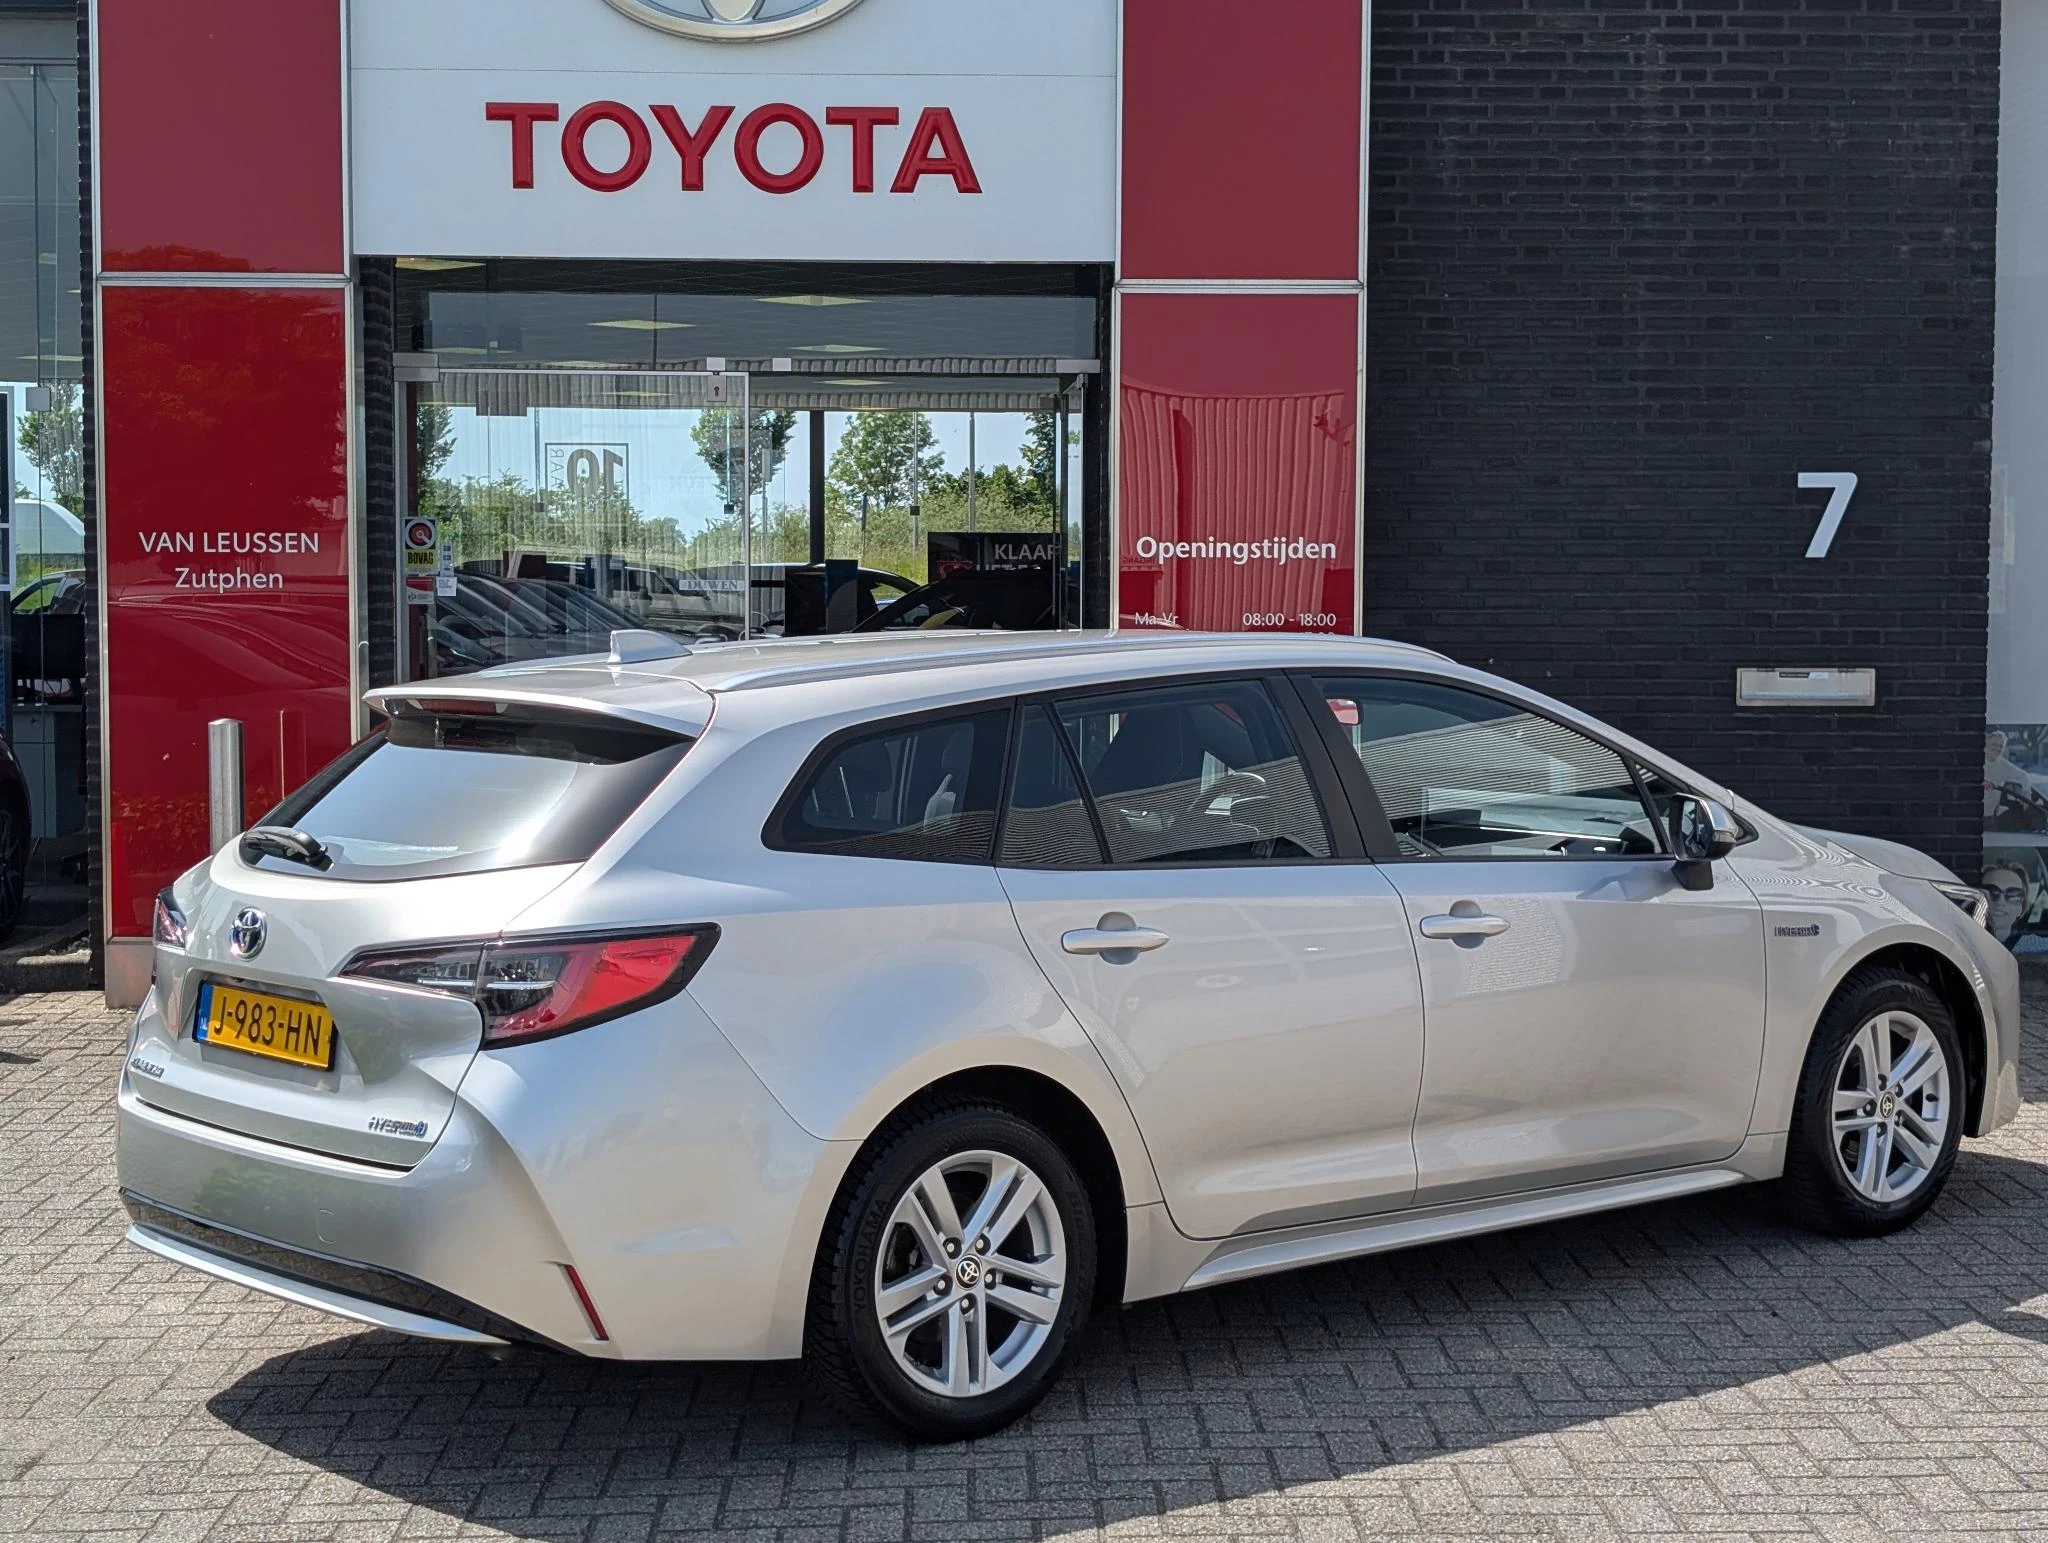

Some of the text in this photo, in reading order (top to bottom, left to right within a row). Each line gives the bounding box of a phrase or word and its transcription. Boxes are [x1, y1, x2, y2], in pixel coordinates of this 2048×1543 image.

[485, 101, 982, 194] TOYOTA
[1796, 472, 1858, 558] 7
[138, 531, 319, 554] VAN LEUSSEN
[1135, 536, 1337, 565] Openingstijden
[407, 551, 434, 565] BOVAG
[175, 567, 283, 594] Zutphen
[1242, 612, 1285, 626] 08:00
[1299, 612, 1337, 627] 18:00
[213, 996, 322, 1056] J-983-HN
[853, 1198, 888, 1315] YOKOHAMA
